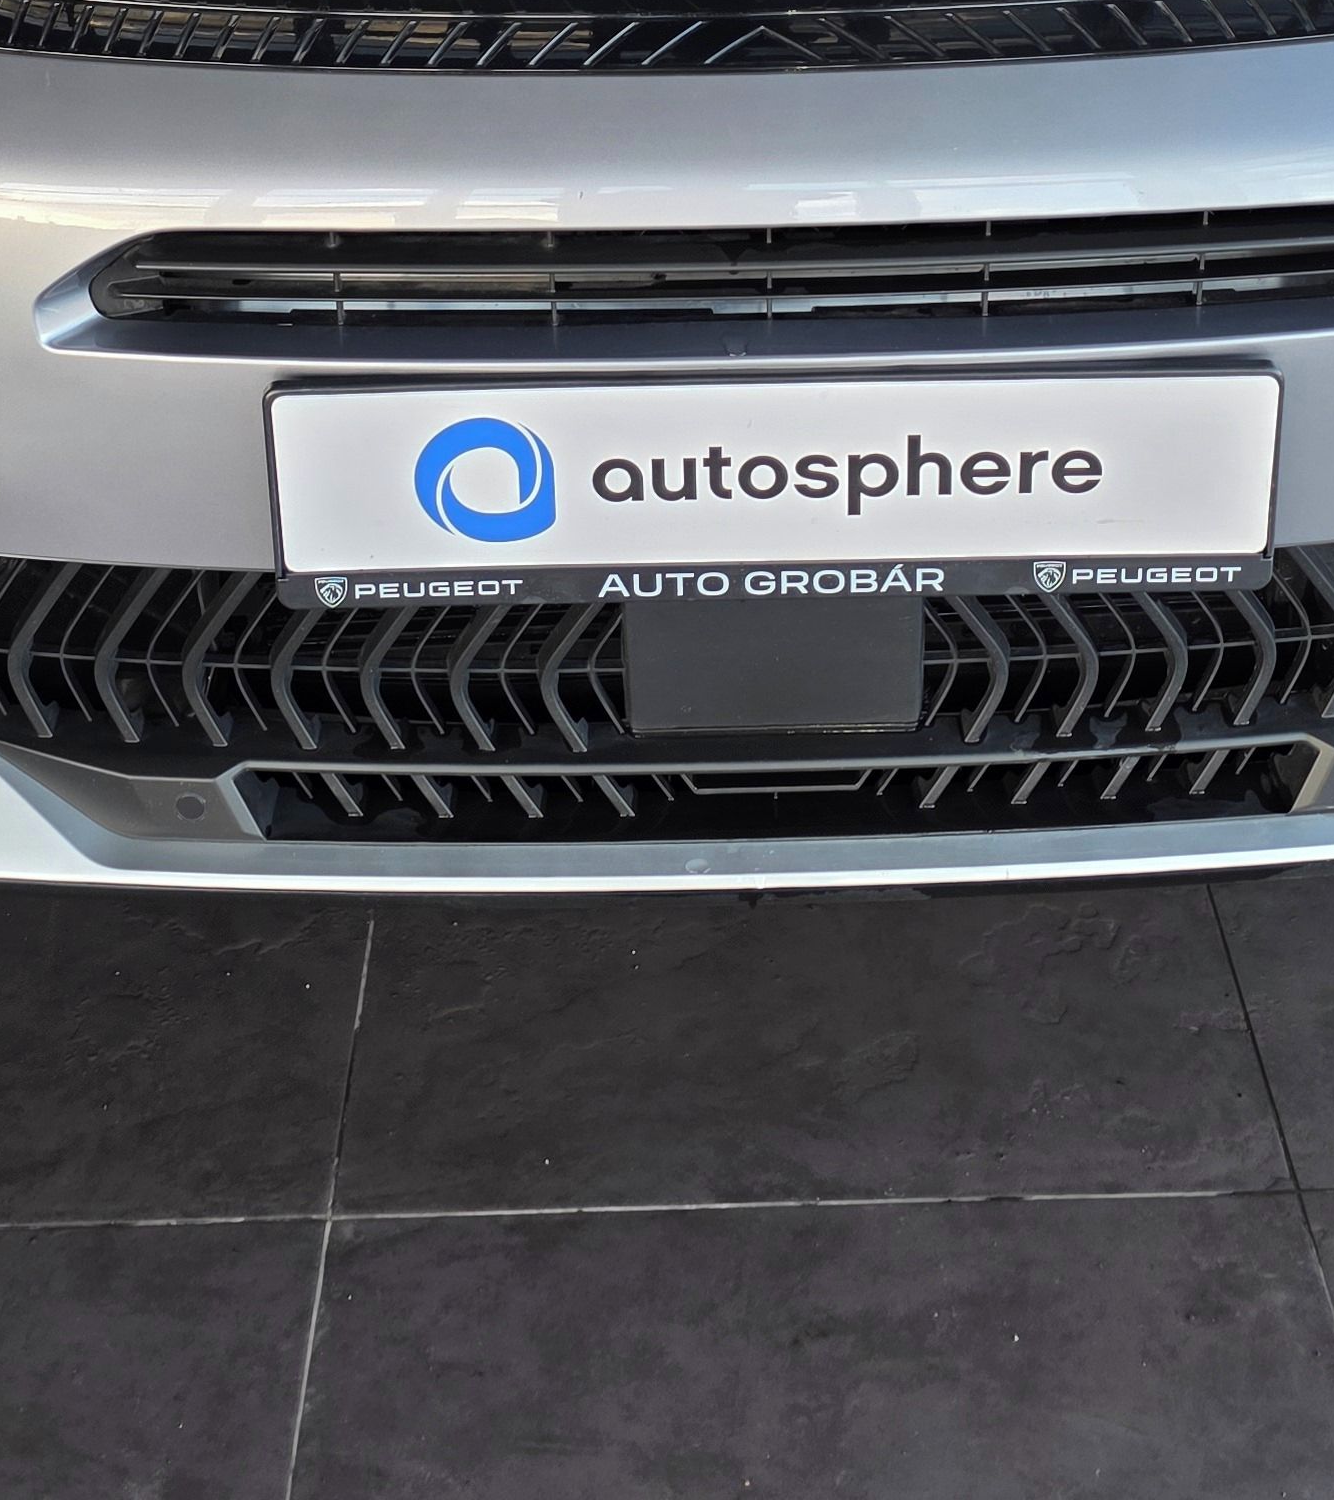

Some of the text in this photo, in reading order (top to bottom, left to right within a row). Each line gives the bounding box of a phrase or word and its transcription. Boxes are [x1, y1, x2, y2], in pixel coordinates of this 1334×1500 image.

[592, 432, 1104, 518] autosphere
[353, 561, 1243, 600] PEUGEOT AUTO GROBÁR PEUGEOT
